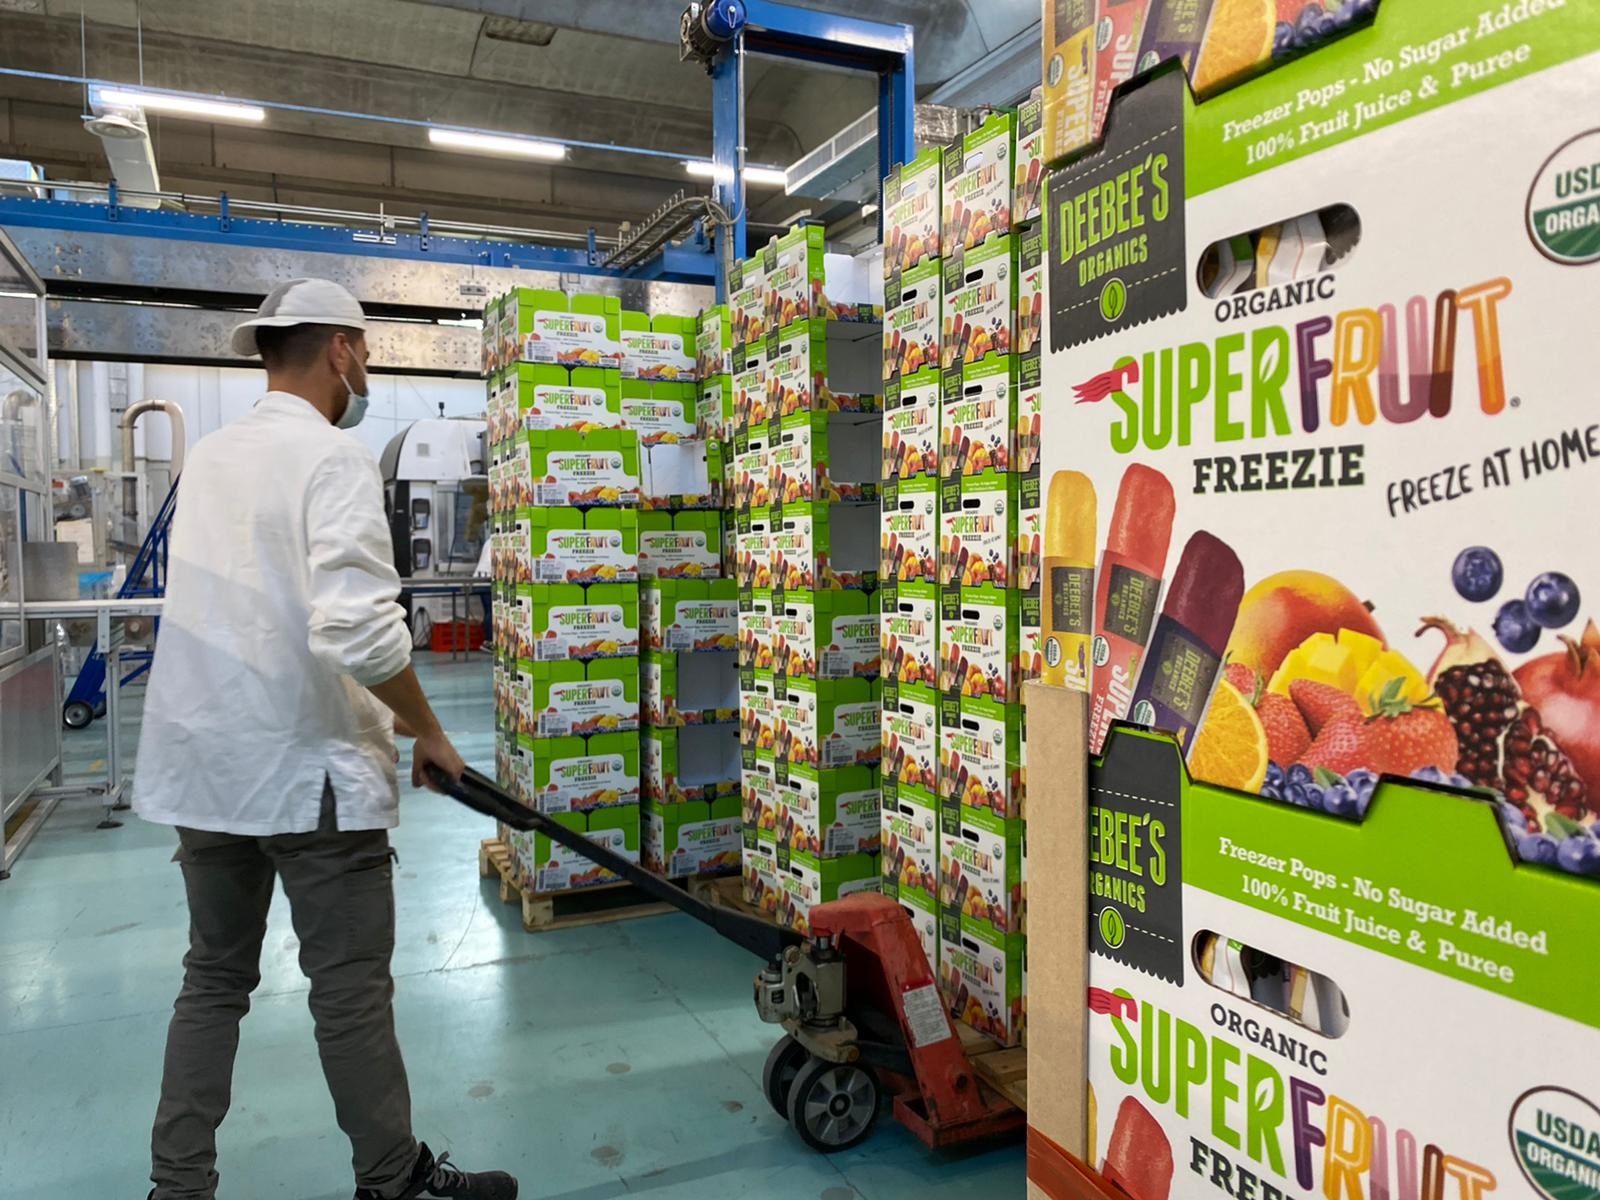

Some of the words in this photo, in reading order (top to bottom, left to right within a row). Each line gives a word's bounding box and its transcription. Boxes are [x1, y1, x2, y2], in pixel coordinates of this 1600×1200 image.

[1222, 103, 1292, 142] Freezer
[1296, 77, 1346, 112] Pops
[1362, 57, 1394, 84] No
[1399, 25, 1472, 70] Sugar
[1246, 130, 1295, 165] 100%
[1299, 107, 1350, 146] Fruit
[1353, 85, 1412, 130] Juice
[1418, 74, 1439, 99] &
[1449, 42, 1531, 88] Puree
[1060, 153, 1169, 265] DEEBEE'S
[1079, 233, 1148, 287] ORGANICS
[1214, 274, 1335, 323] ORGANIC
[1109, 275, 1512, 454] SUPERFRUIT
[1193, 443, 1364, 494] FREEZIE
[1386, 463, 1473, 518] FREEZE
[1482, 447, 1511, 489] AT
[1520, 423, 1600, 480] HOME
[1068, 573, 1082, 627] DEEBEE'S
[1123, 576, 1144, 636] DEEBEE'S
[1173, 649, 1200, 711] DEEBEE'S
[1090, 806, 1166, 886] EBEE'S
[1090, 871, 1146, 913] RGANICS
[1219, 837, 1286, 873] Freezer
[1289, 857, 1337, 890] Pops
[1353, 876, 1383, 903] No
[1388, 887, 1456, 926] Sugar
[1460, 909, 1548, 955] Added
[1241, 874, 1289, 907] 100%
[1292, 891, 1341, 925] Fruit
[1345, 909, 1401, 945] Juice
[1406, 930, 1427, 953] &
[1438, 937, 1515, 984] Puree
[1210, 1003, 1328, 1078] ORGANIC
[1536, 1108, 1600, 1159] USDA
